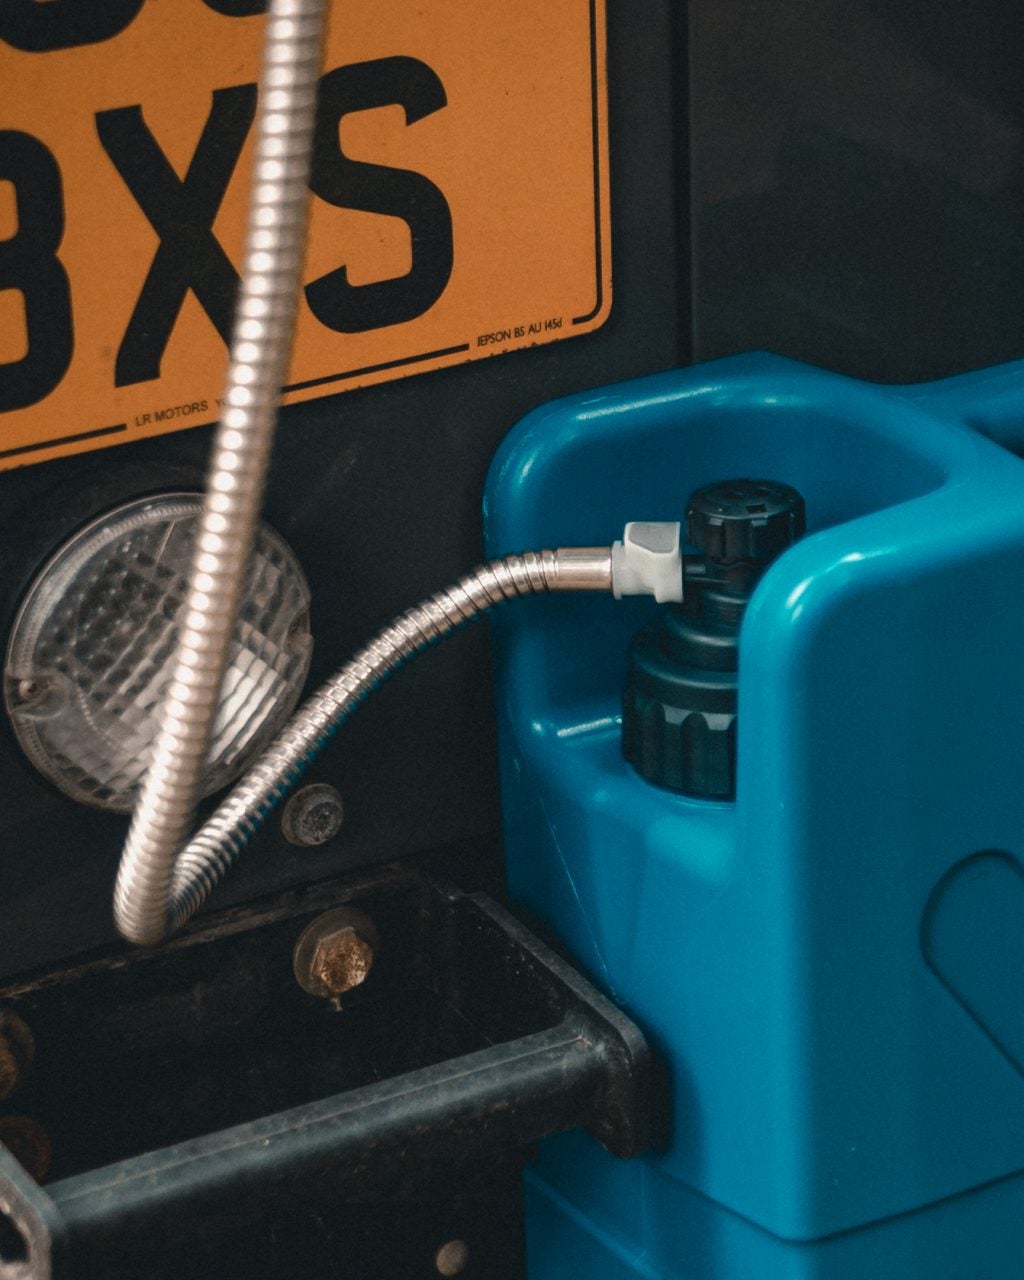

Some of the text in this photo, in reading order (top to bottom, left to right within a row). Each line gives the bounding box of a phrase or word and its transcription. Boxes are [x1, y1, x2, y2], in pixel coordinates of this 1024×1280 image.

[514, 325, 525, 338] BS
[528, 321, 542, 335] AU
[135, 413, 152, 427] LR
[155, 400, 209, 422] MOTORS
